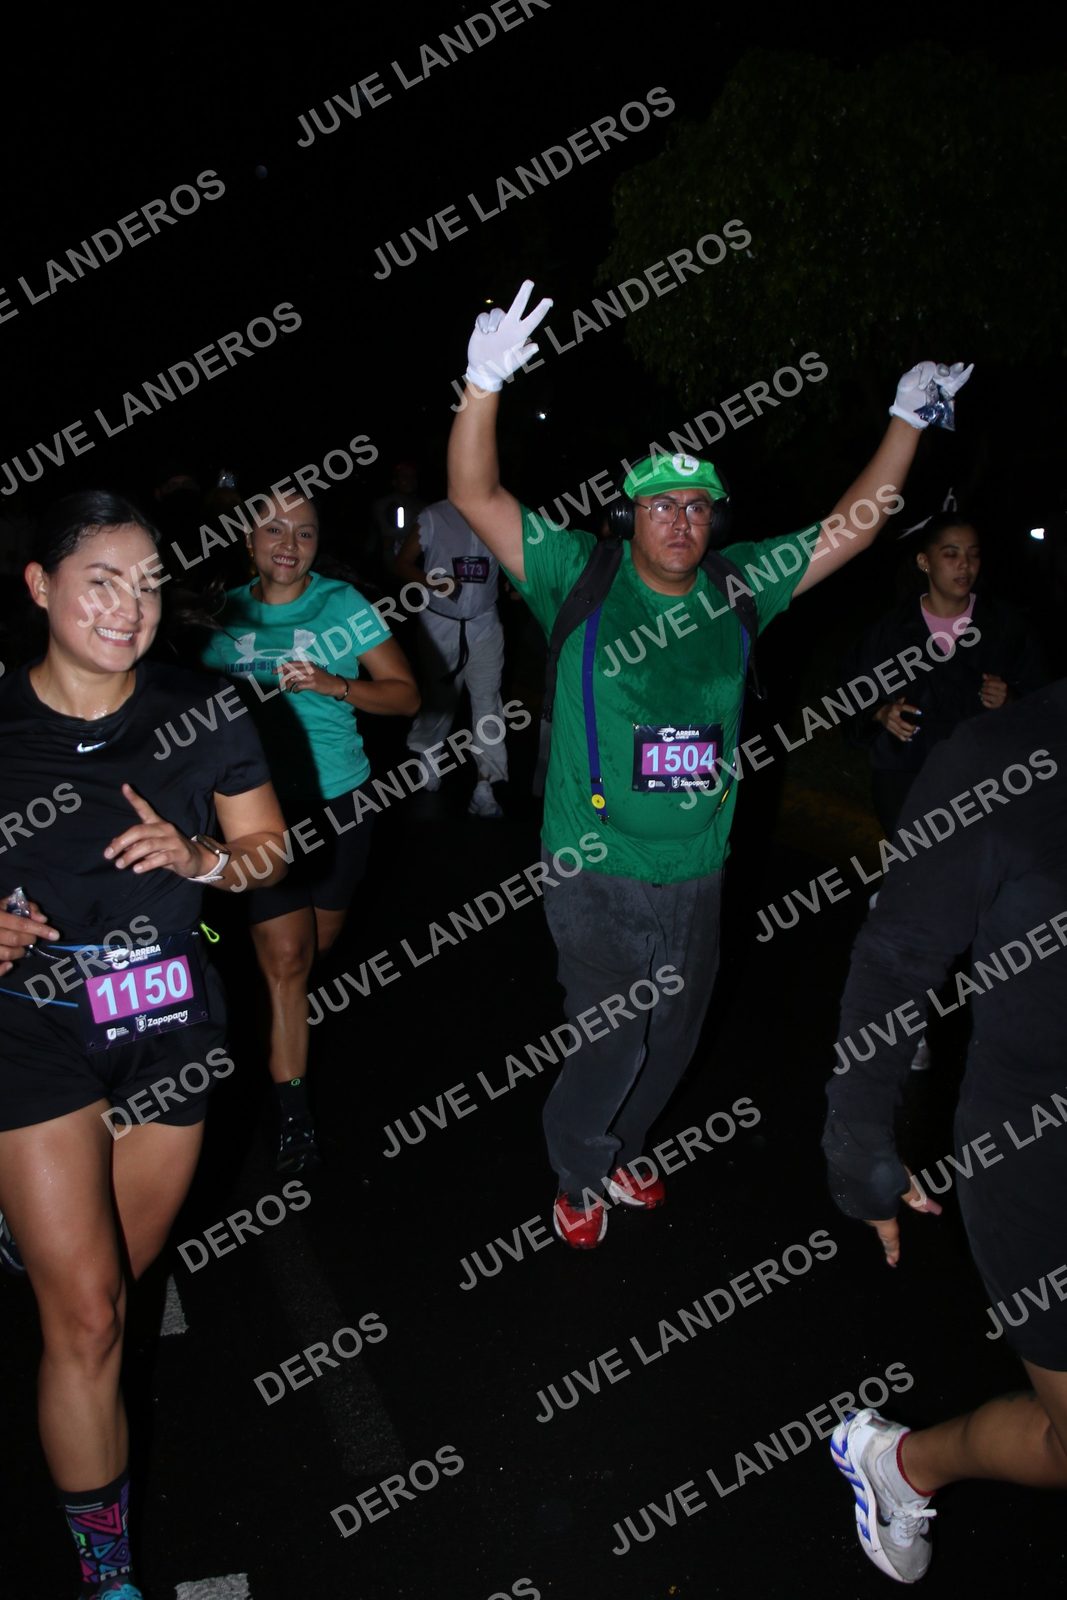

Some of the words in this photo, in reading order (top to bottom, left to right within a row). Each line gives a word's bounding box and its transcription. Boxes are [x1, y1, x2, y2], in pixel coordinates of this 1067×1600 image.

[681, 455, 694, 471] L
[462, 563, 483, 576] 173
[646, 743, 715, 772] 1504
[97, 960, 188, 1016] 1150
